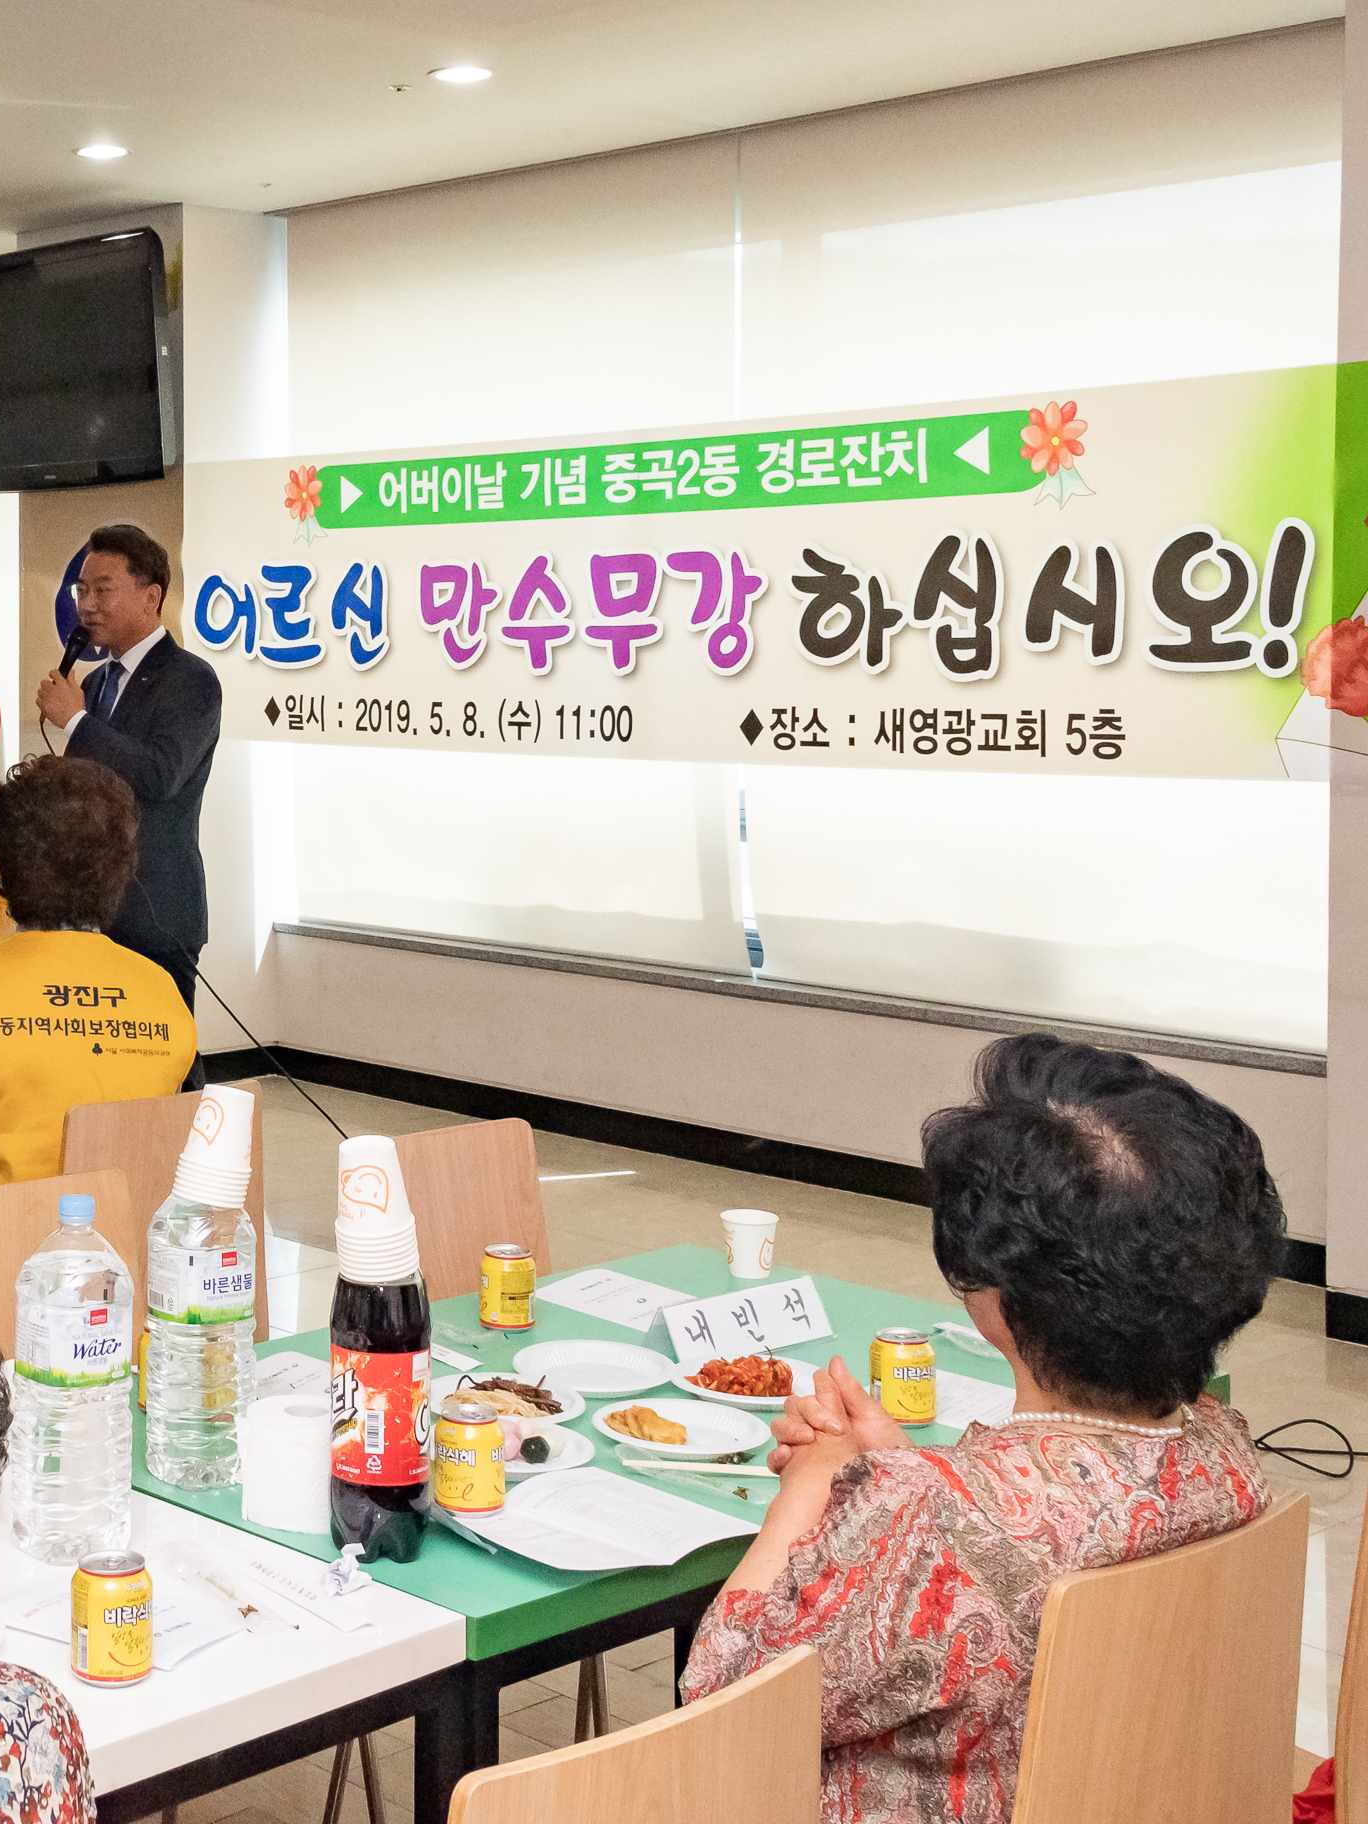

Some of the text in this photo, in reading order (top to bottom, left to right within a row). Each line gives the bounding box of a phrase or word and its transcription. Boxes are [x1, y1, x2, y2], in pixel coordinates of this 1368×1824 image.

[378, 427, 928, 514] 어버이날 기념 중곡2동 경로잔치
[193, 522, 1310, 676] 어르신 만수무강 하십시오!
[285, 694, 326, 733] 일시
[355, 698, 418, 736] 2019.
[430, 702, 451, 737] 5.
[462, 703, 485, 739] 8.
[498, 698, 542, 743] (수)
[555, 705, 633, 742] 11:00
[769, 707, 830, 749] 장소
[874, 708, 1047, 758] 새영광교회
[1066, 709, 1126, 760] 5층
[42, 984, 128, 1008] 광진구
[203, 1272, 253, 1295] 바른샘물
[73, 1338, 122, 1360] Water
